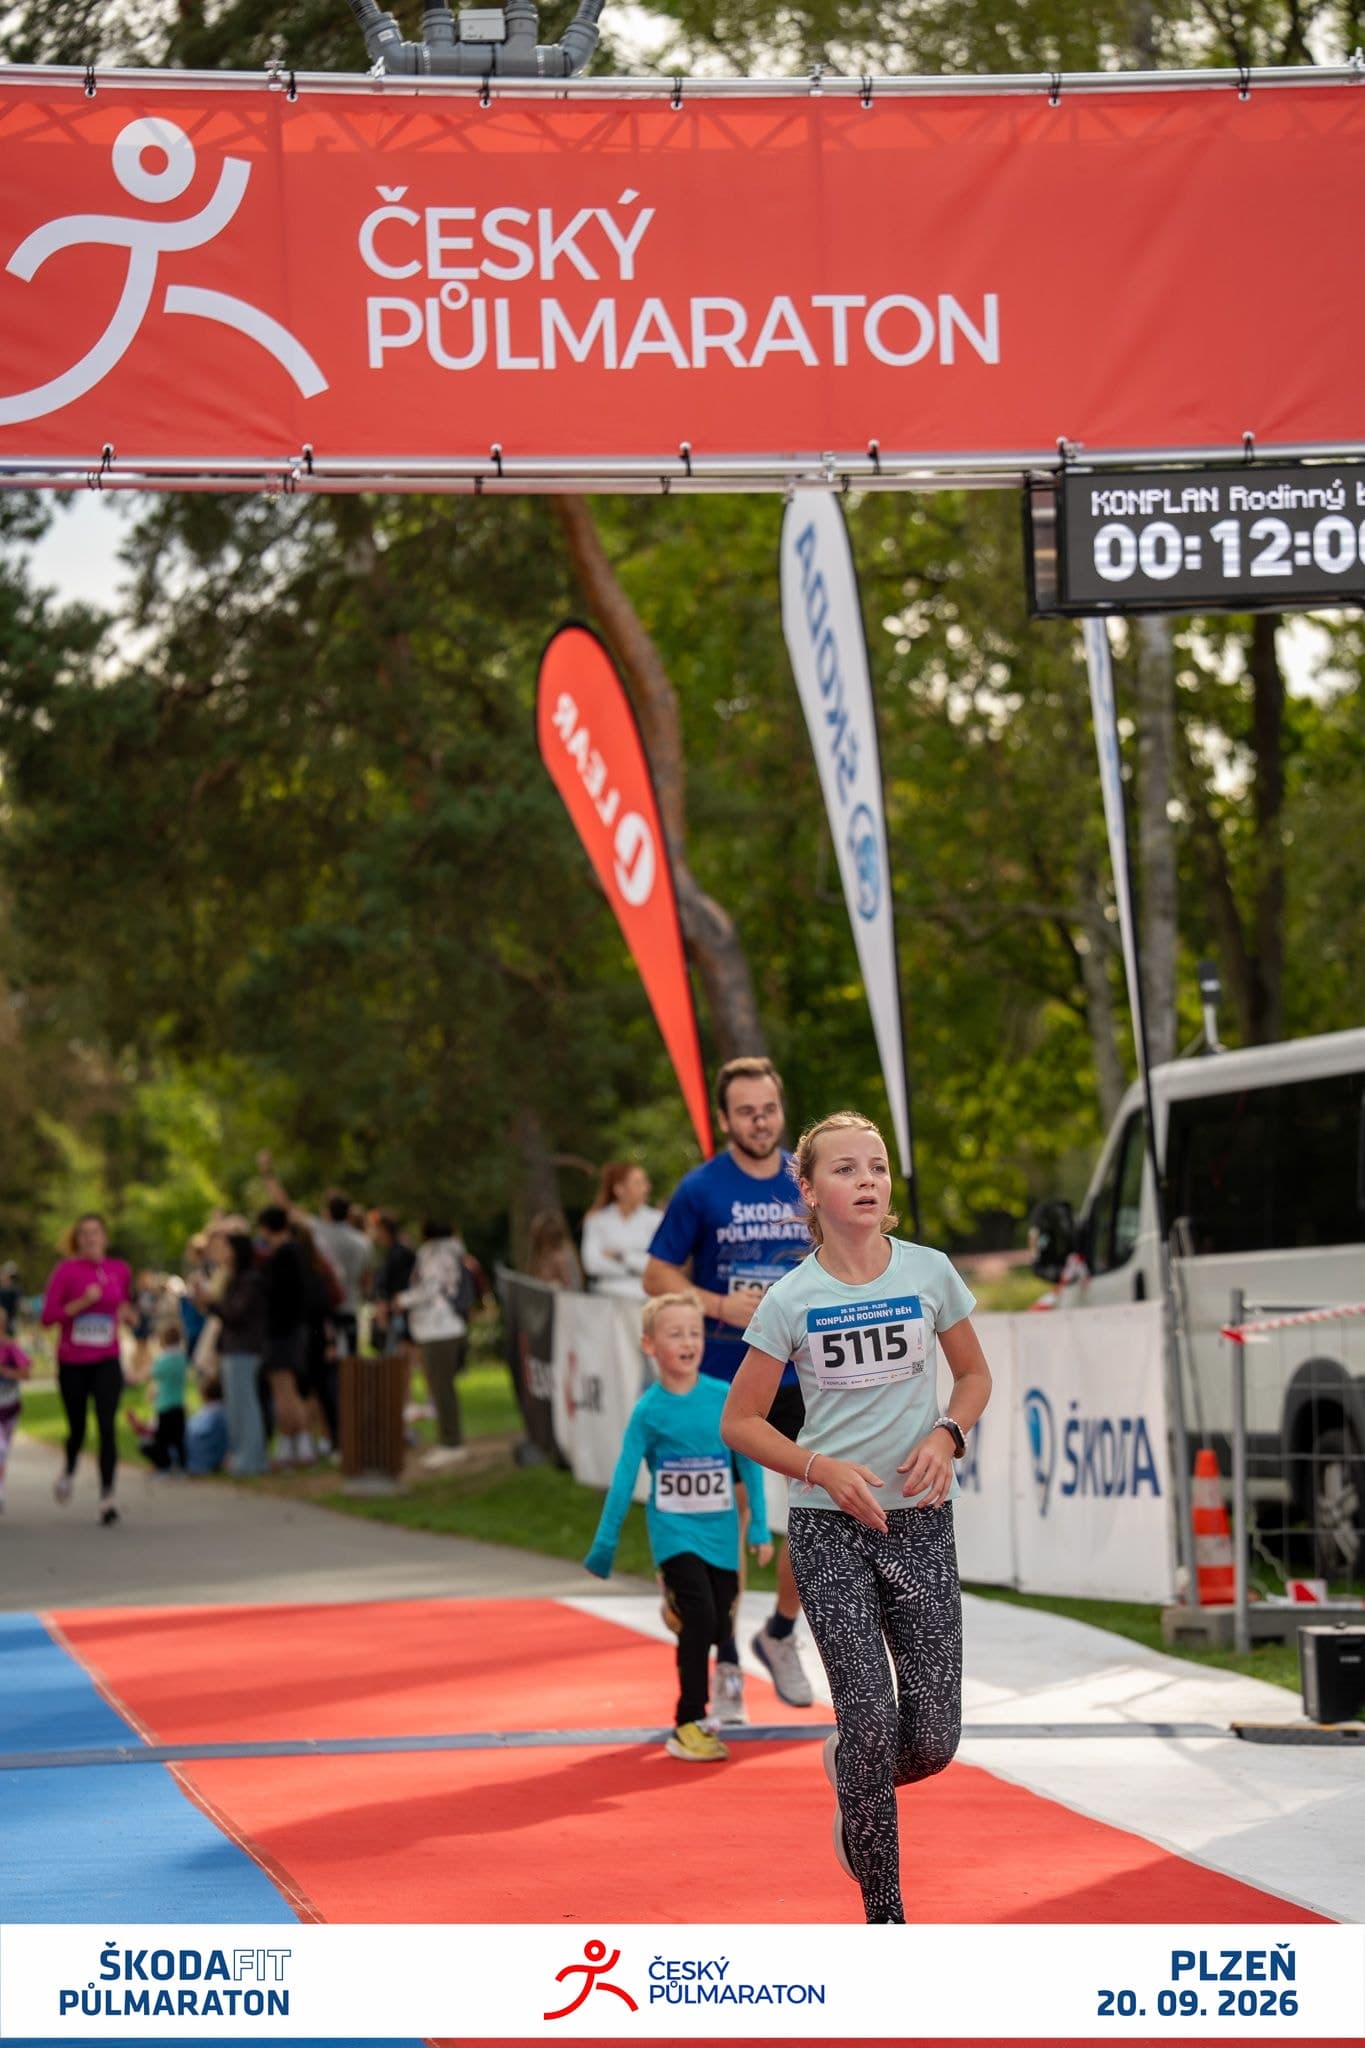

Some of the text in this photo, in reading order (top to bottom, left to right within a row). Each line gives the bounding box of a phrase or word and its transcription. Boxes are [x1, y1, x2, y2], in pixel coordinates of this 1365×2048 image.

[359, 186, 655, 281] ČESKÝ
[367, 281, 1000, 370] PŮLMARATON
[1090, 486, 1220, 517] KONPLAN
[1229, 478, 1347, 512] Rodinný
[1093, 515, 1365, 581] 00:12:0
[731, 1200, 796, 1224] ŠKODA
[715, 1221, 816, 1245] PŮLMARATO
[815, 1304, 912, 1327] KONPLAN RODINNÝ BĚH
[822, 1324, 908, 1368] 5115
[1061, 1401, 1161, 1497] ŠKODA
[660, 1472, 725, 1496] 5002
